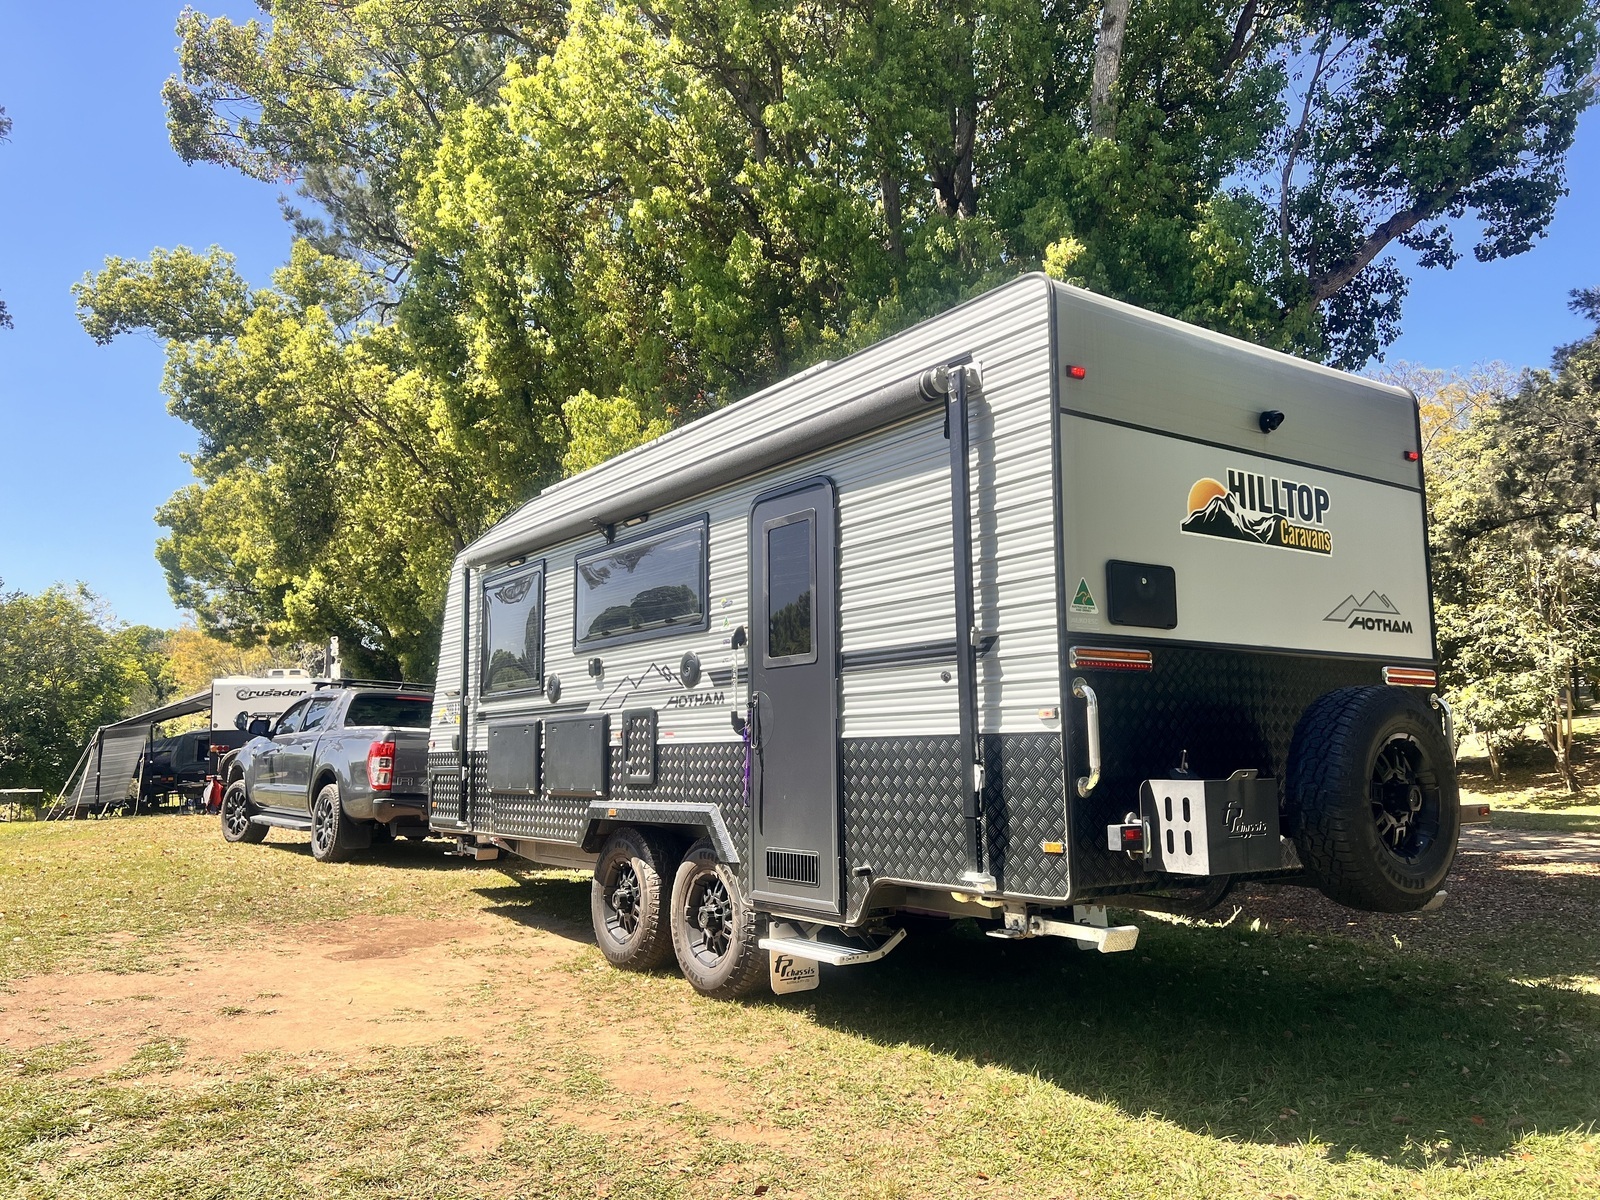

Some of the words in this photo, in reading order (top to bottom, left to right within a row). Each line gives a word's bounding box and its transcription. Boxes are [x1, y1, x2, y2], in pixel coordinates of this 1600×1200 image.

[1228, 469, 1330, 525] HILLTOP
[1279, 519, 1333, 553] Caravans
[1347, 616, 1413, 634] HOTHAM
[662, 691, 725, 709] HOTHAM
[786, 966, 815, 978] chassis
